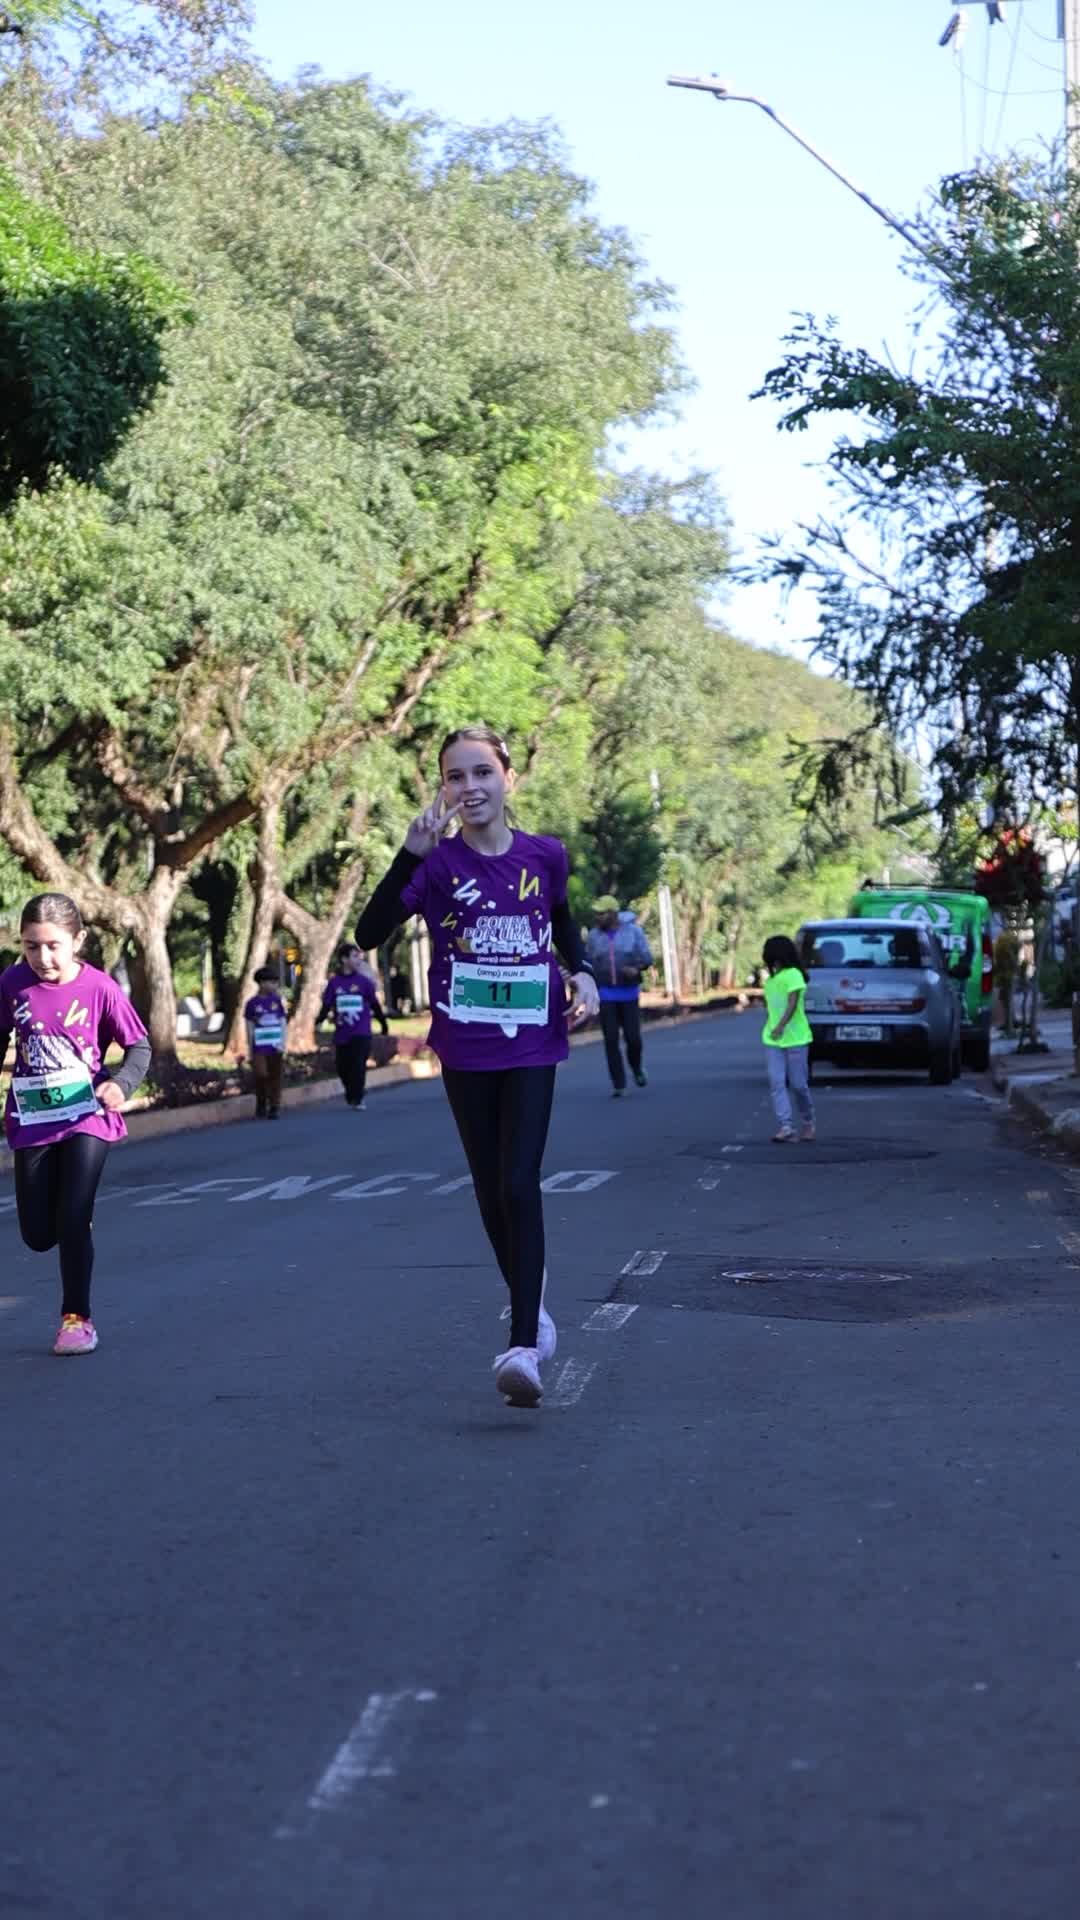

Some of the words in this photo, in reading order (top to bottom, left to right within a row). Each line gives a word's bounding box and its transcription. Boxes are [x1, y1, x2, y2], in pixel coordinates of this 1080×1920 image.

[476, 915, 530, 930] CORRA
[463, 927, 498, 940] POR
[499, 926, 533, 941] UMA
[488, 981, 512, 1002] 11
[40, 1087, 64, 1105] 63
